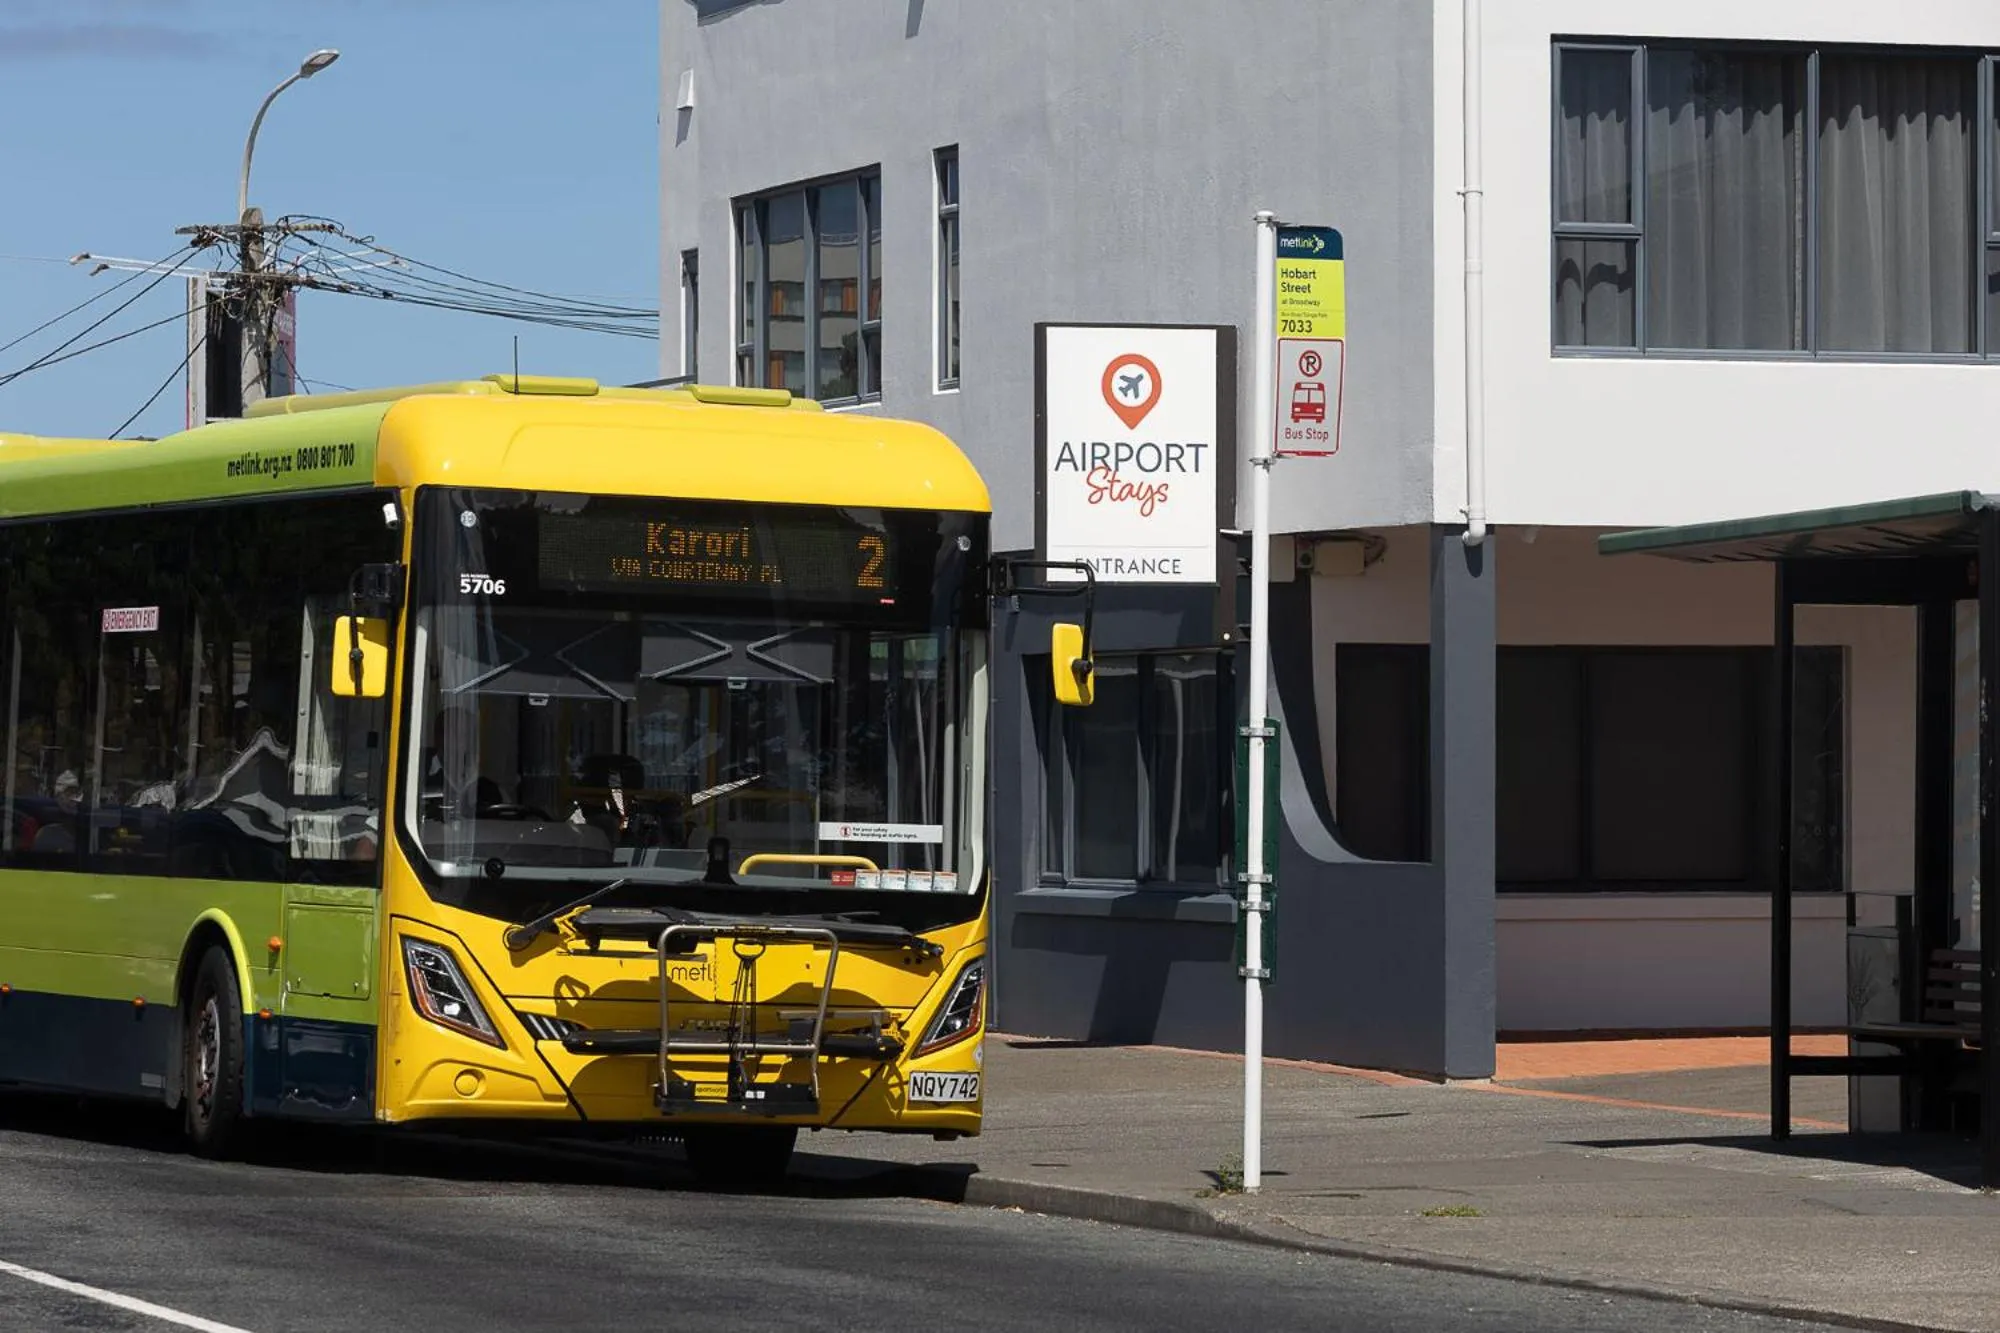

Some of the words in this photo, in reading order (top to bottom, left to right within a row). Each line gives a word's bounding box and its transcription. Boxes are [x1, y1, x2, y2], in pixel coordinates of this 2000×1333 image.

[1280, 237, 1314, 248] metlink
[1281, 268, 1316, 279] Hobart
[1281, 282, 1311, 293] Street
[1281, 319, 1313, 333] 7033
[1285, 428, 1303, 440] Bus
[1306, 428, 1329, 442] Stop
[227, 452, 293, 479] metlink.org.nz
[297, 447, 318, 470] 0800
[320, 445, 337, 469] 801
[338, 443, 355, 467] 700
[1054, 441, 1209, 474] AIRPORT
[1086, 466, 1169, 518] Stays
[647, 523, 749, 558] Karori
[649, 560, 753, 582] COURTENAY
[760, 564, 782, 583] PL
[857, 536, 884, 587] 2
[460, 578, 506, 595] 5706
[111, 610, 143, 630] EMERGENCY
[143, 609, 156, 629] EXIT
[912, 1076, 978, 1098] NQY742
